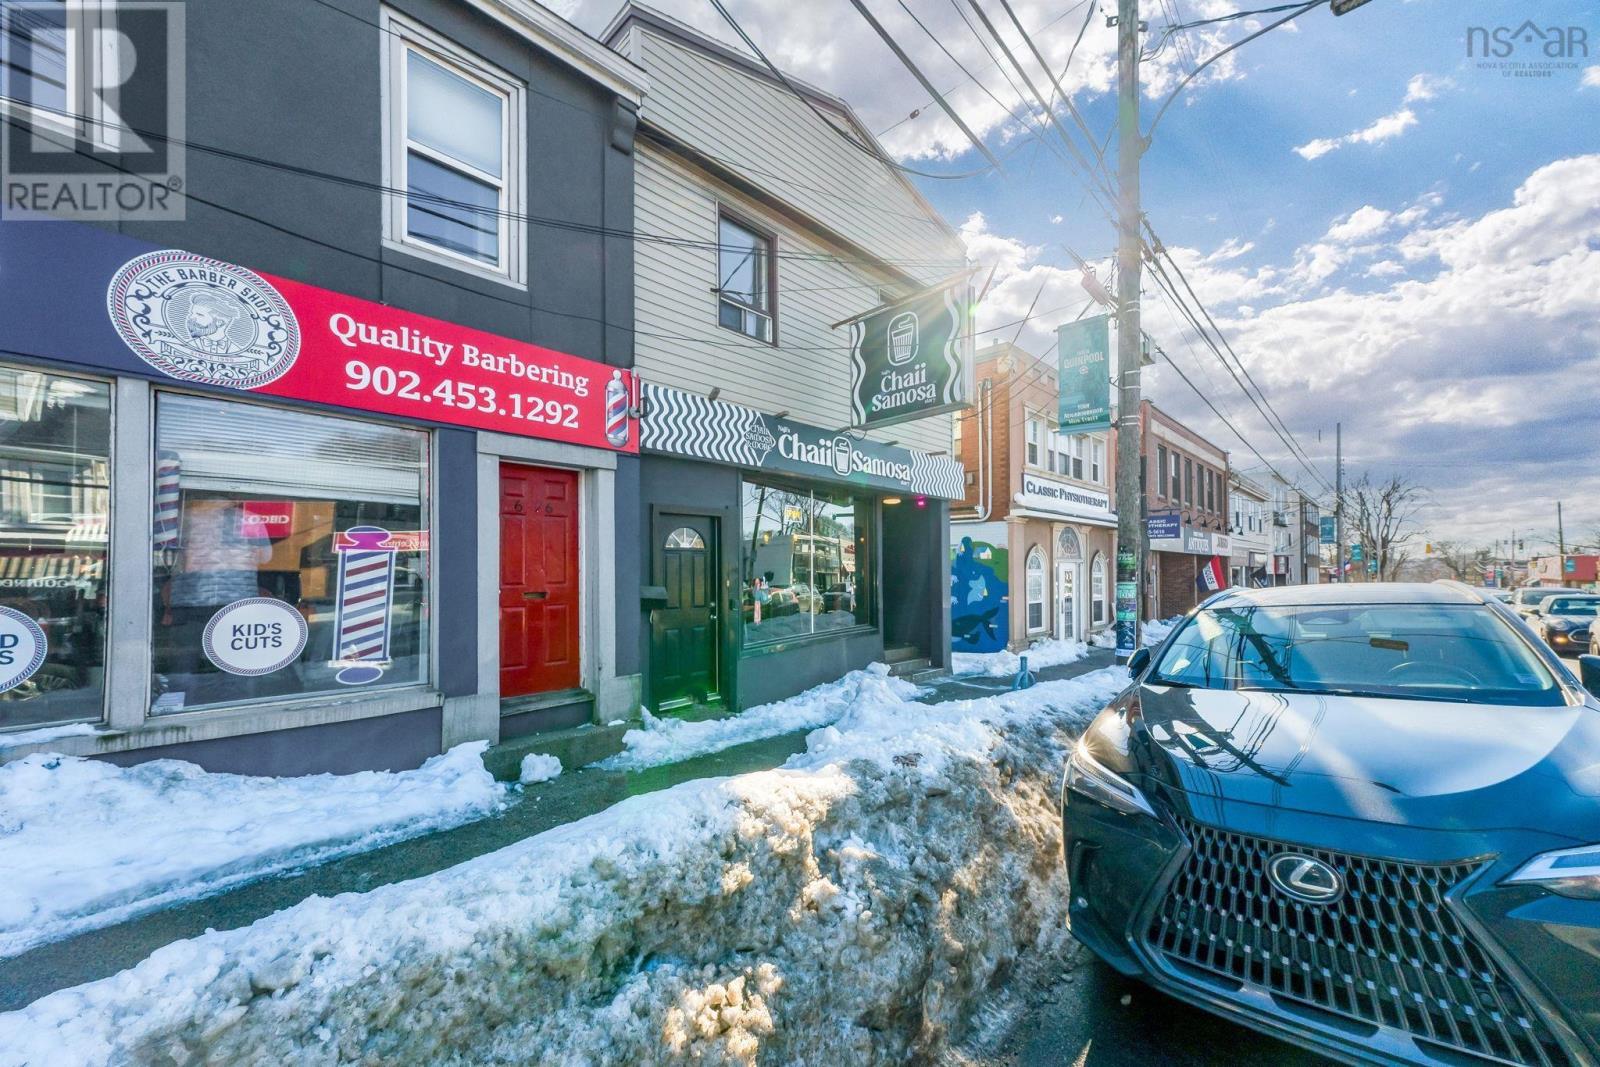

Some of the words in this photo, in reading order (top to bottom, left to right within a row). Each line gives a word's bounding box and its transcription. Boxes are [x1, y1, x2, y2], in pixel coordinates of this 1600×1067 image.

[145, 270, 176, 290] THE
[177, 268, 237, 290] BARBER
[240, 286, 272, 314] SHOP
[328, 312, 453, 366] Quality
[461, 343, 589, 397] Barbering
[344, 360, 579, 429] 902.453.1292
[880, 362, 926, 393] Chaii
[778, 432, 832, 467] Chaii
[852, 450, 911, 481] Samosa
[1026, 481, 1059, 499] CLASSIC
[1059, 488, 1108, 508] PHYSIOTHERAPY
[230, 636, 282, 651] CUTS
[232, 623, 282, 637] KID'S
